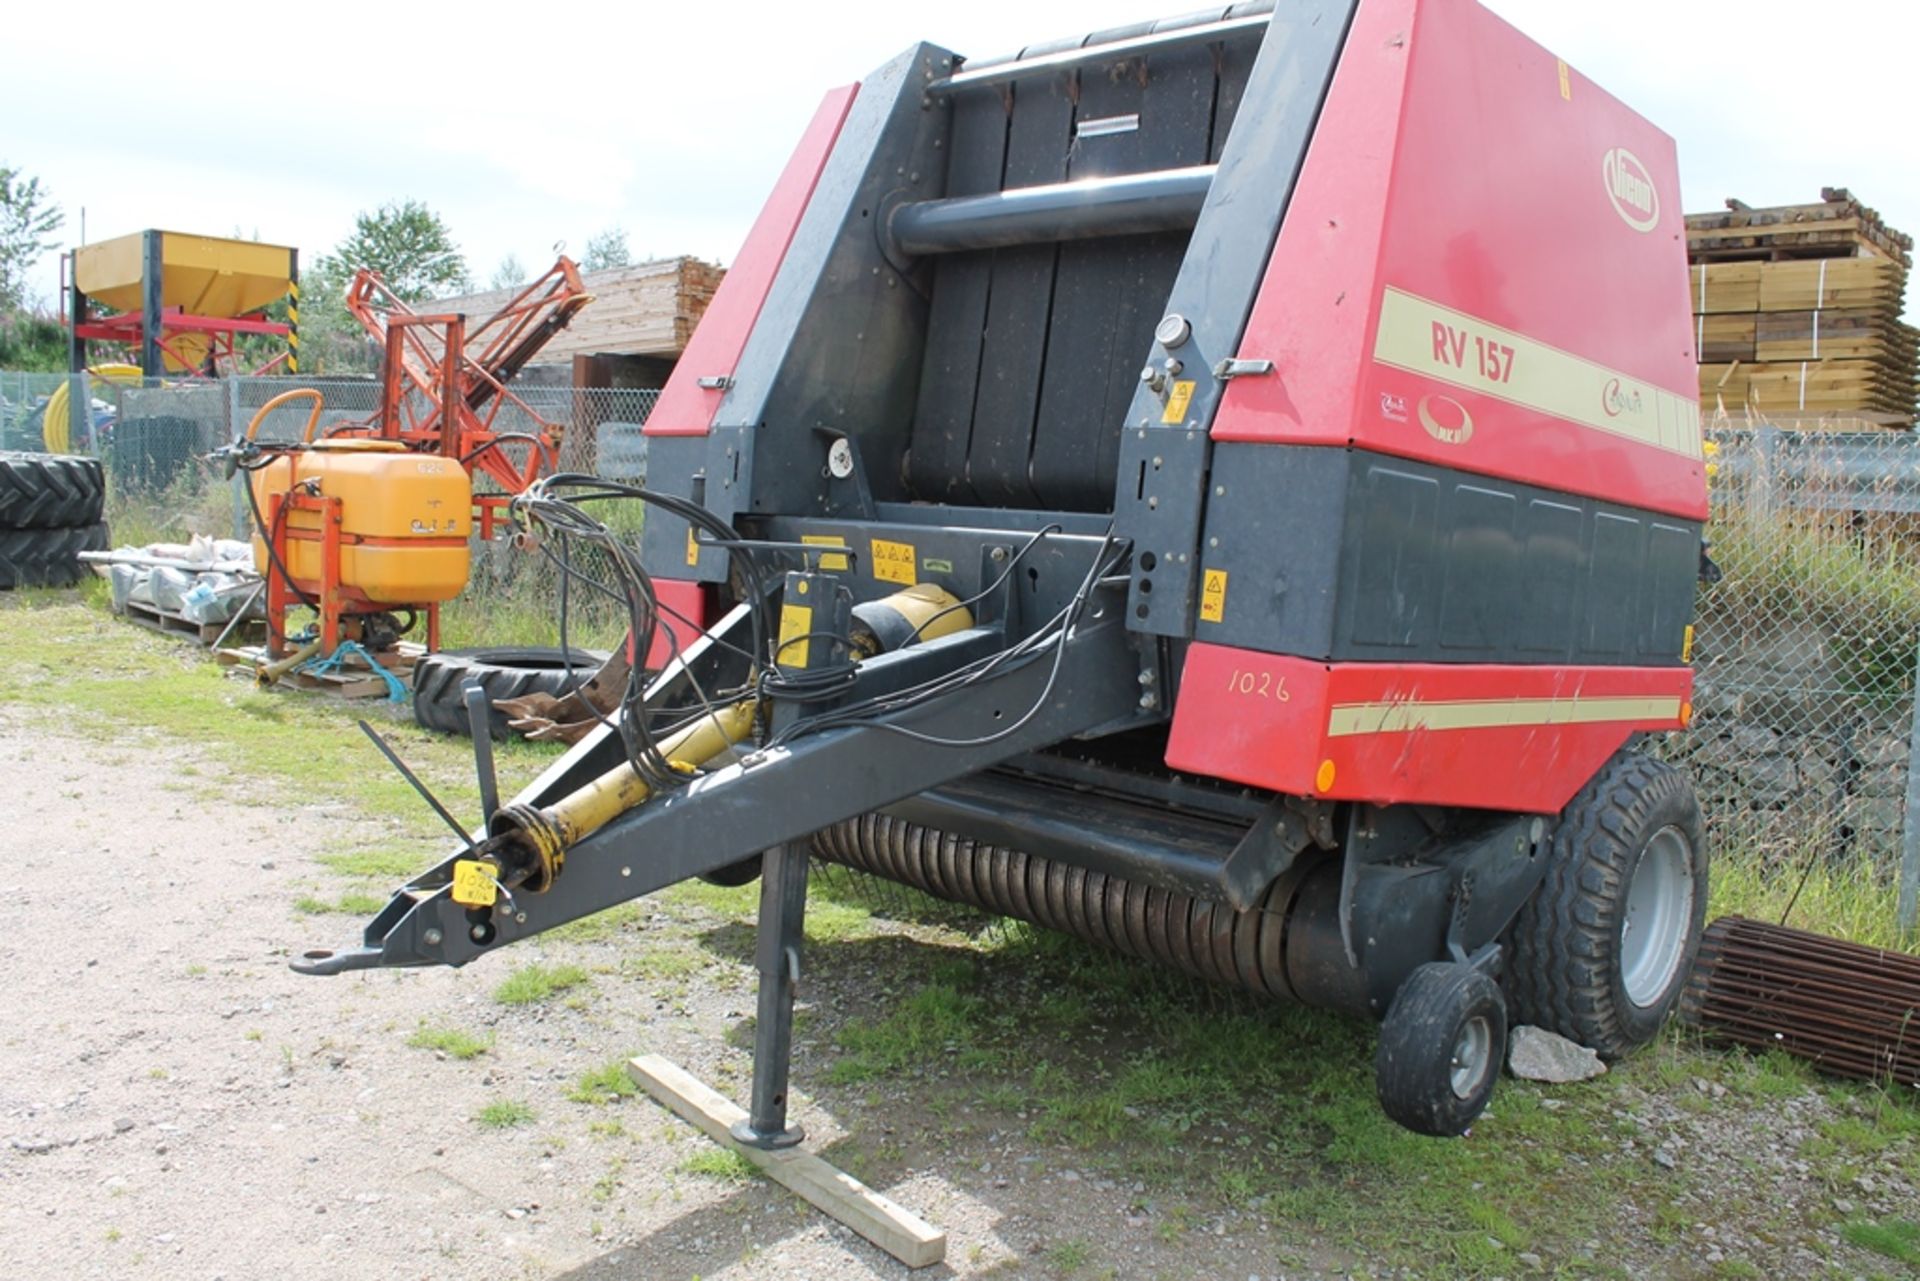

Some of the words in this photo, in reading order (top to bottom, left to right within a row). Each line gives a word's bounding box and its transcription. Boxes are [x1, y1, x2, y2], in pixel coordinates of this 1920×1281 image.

[1432, 320, 1466, 369] RV
[1475, 336, 1514, 383] 157
[1229, 670, 1290, 702] 1026
